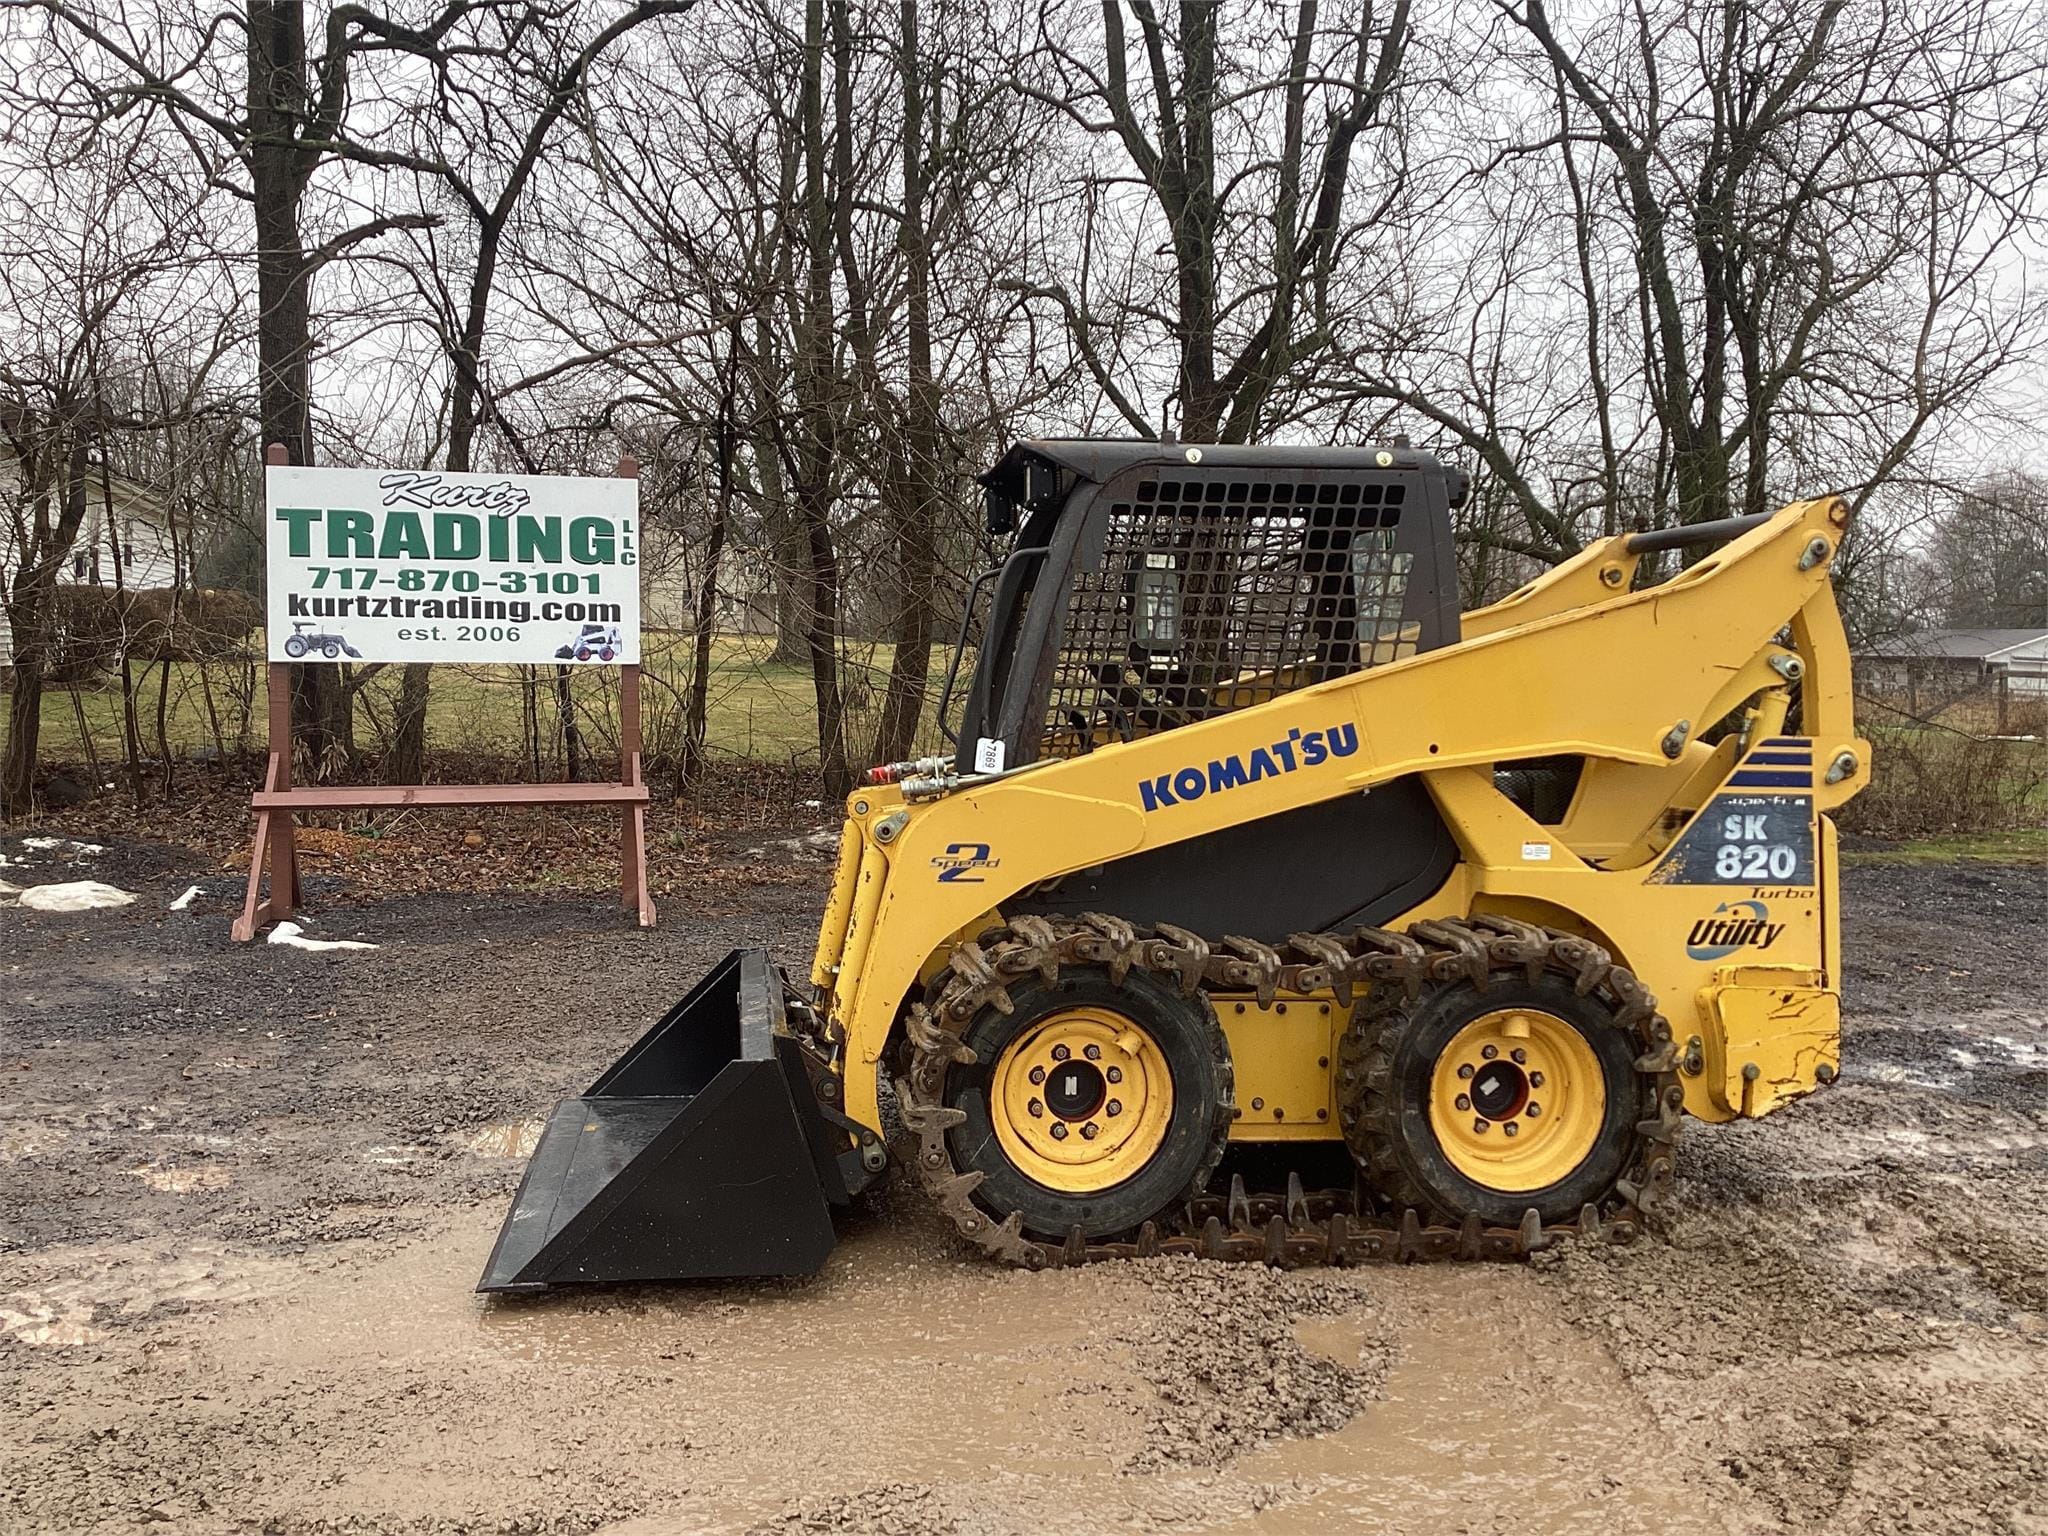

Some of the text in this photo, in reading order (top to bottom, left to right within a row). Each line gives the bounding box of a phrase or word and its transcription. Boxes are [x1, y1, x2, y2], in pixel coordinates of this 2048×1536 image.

[379, 472, 531, 518] Kurtz
[275, 508, 616, 565] TRADING
[622, 518, 637, 566] LLC
[306, 566, 601, 595] 717-870-3101
[288, 593, 622, 623] kurtztrading.com
[397, 626, 521, 642] est. 2006
[985, 745, 997, 769] 7869
[1138, 722, 1360, 812] KOMATSU
[1724, 814, 1768, 840] SK
[930, 856, 1001, 869] Speed
[1715, 844, 1798, 880] 820
[1750, 887, 1814, 899] Turbo
[1687, 918, 1786, 950] Utility
